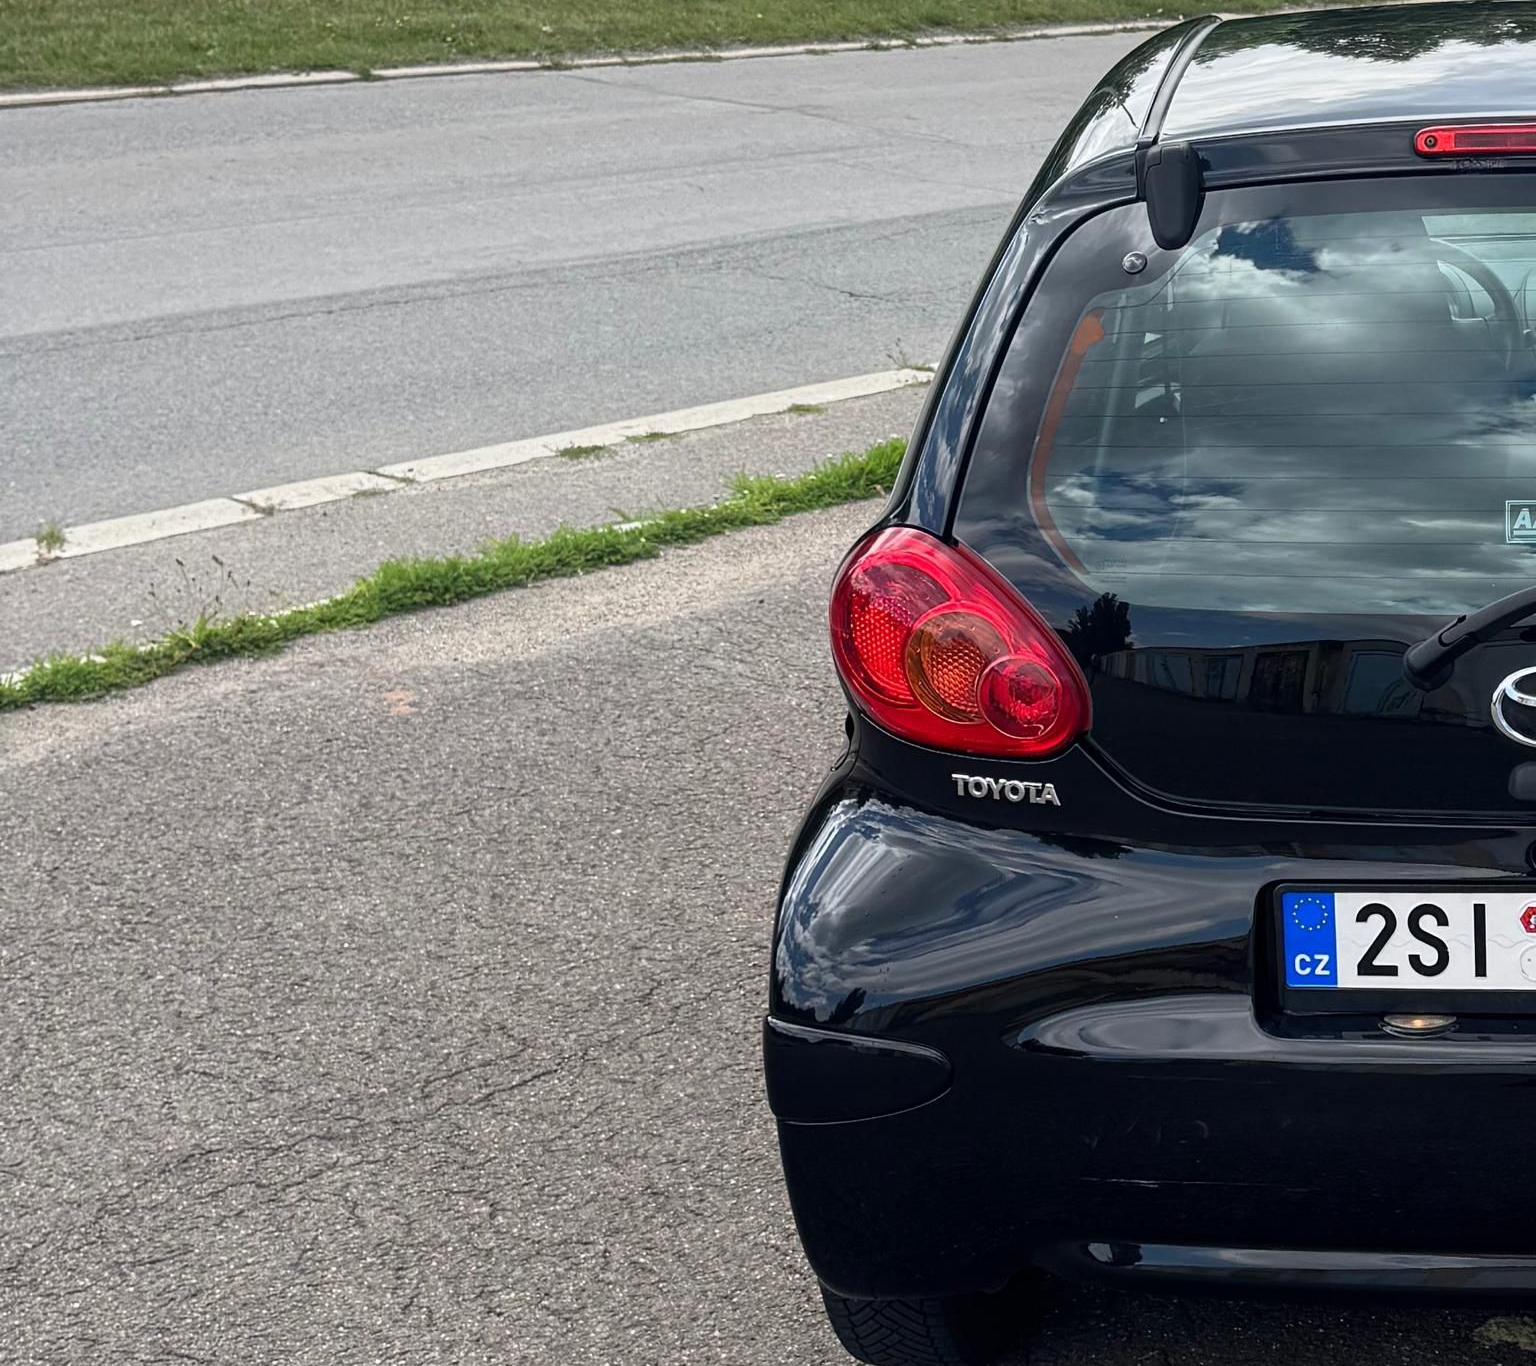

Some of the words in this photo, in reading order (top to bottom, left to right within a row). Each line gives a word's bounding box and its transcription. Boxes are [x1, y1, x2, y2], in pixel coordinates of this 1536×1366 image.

[952, 774, 1061, 806] TOYOTA
[1355, 902, 1488, 979] 2SI
[1294, 953, 1330, 976] CZ
